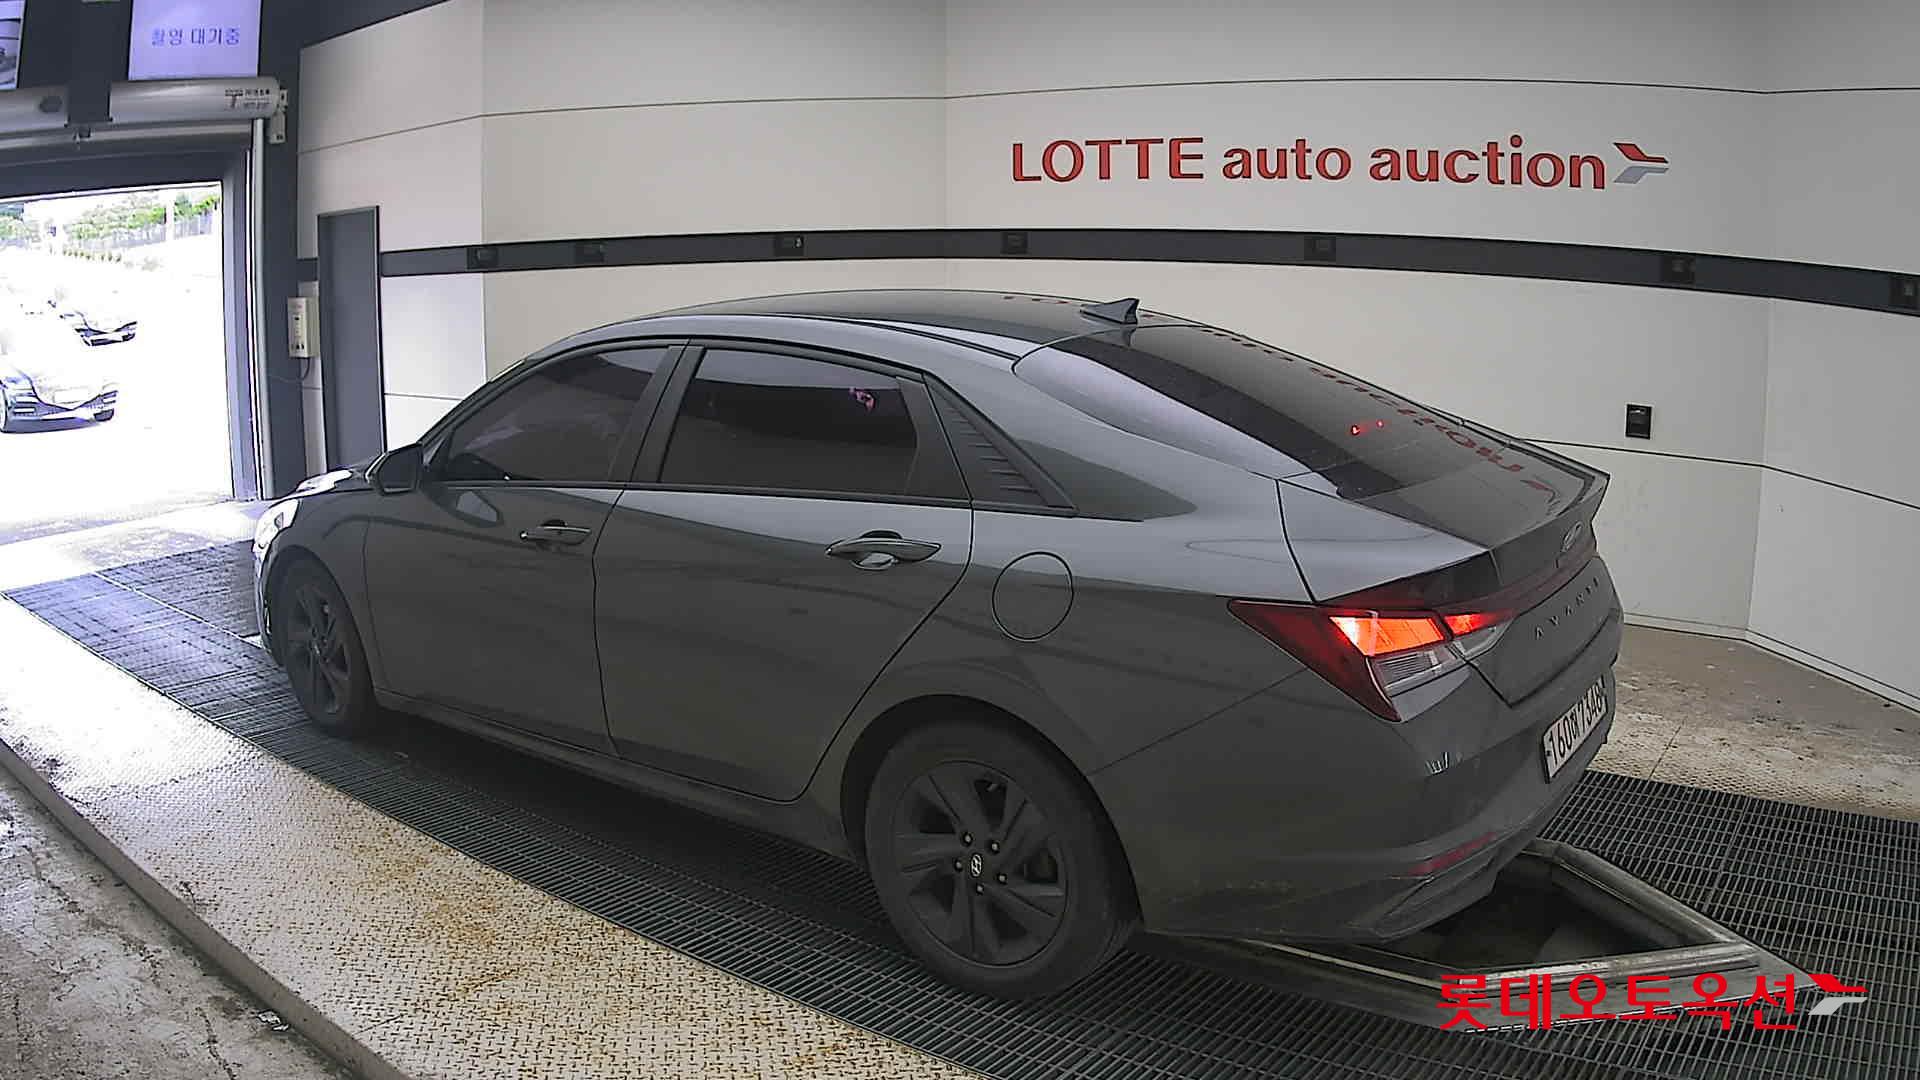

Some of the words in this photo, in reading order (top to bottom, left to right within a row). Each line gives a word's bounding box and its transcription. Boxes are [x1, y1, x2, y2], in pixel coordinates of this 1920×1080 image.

[191, 27, 240, 46] 대기중
[1012, 137, 1204, 182] LOTTE
[1222, 138, 1352, 181] auto
[1369, 135, 1606, 190] auction
